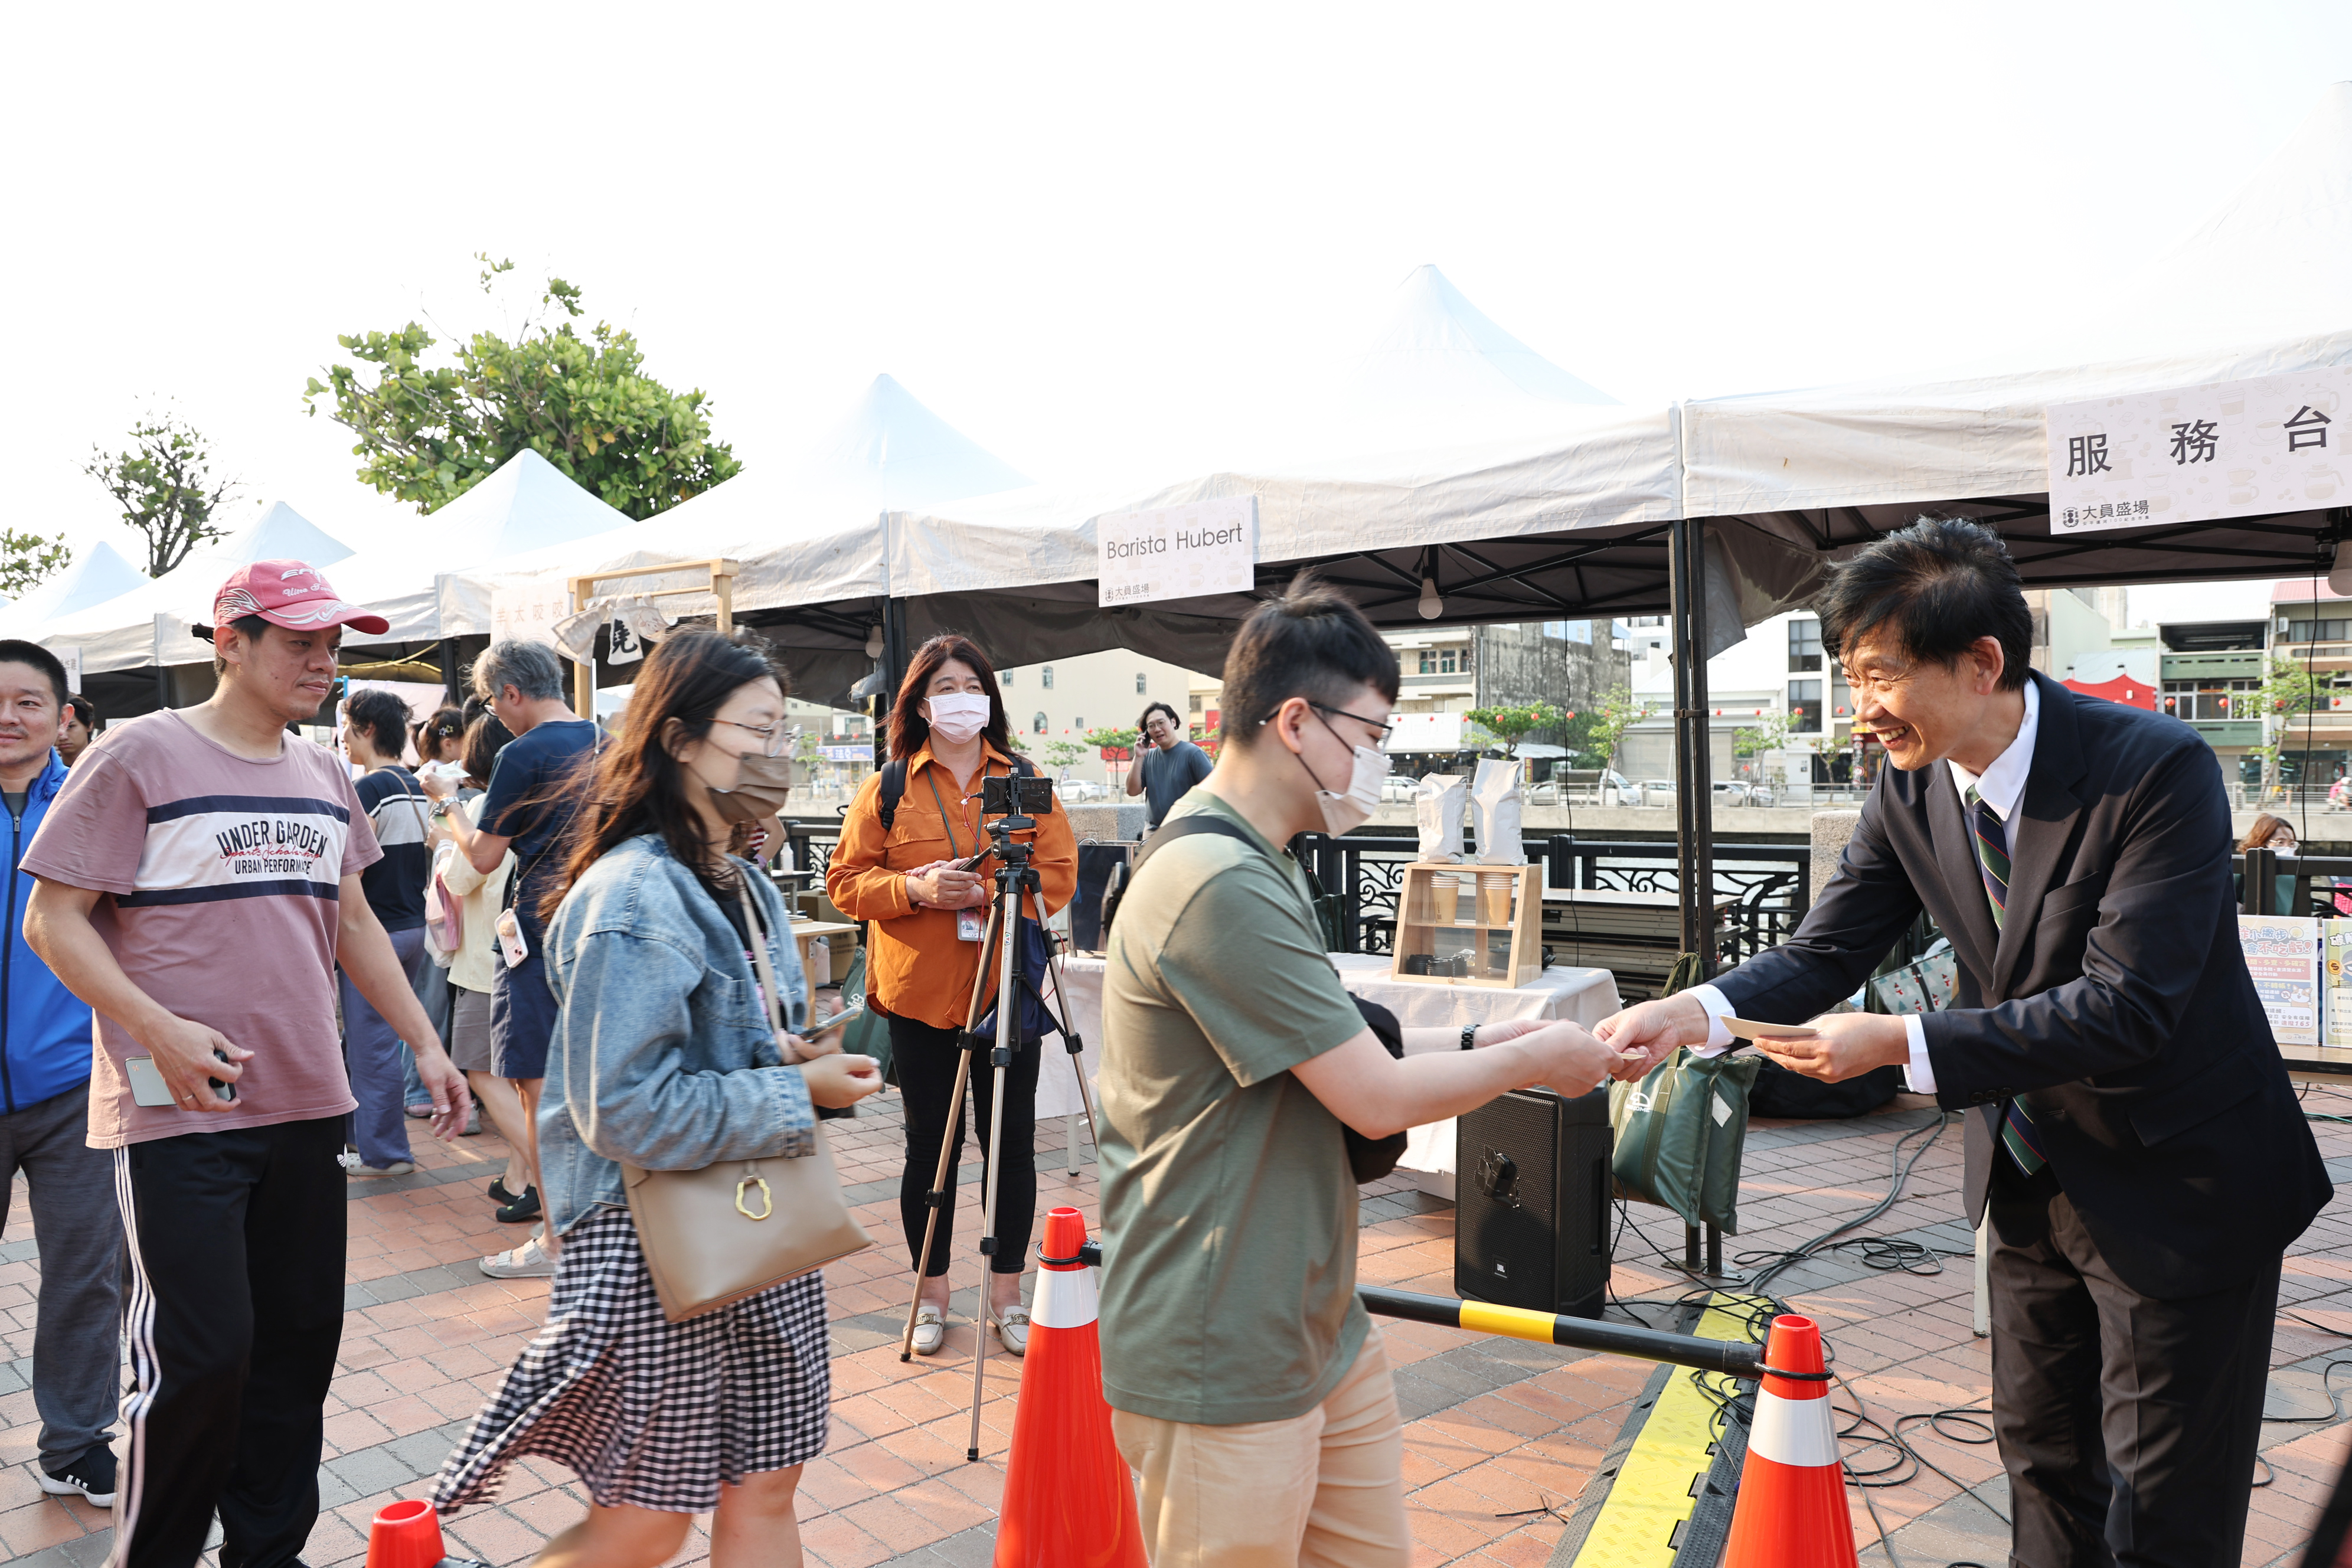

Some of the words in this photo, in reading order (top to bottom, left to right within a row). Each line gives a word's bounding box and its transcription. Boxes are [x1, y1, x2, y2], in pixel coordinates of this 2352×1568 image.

[2067, 405, 2333, 477] 服務台
[2082, 499, 2150, 520] 大員盛場
[1107, 535, 1167, 560] Barista
[1177, 522, 1243, 550] Hubert
[1115, 583, 1150, 597] 大員盛場
[216, 820, 269, 857] UNDER
[276, 819, 328, 858] GARDEN
[220, 845, 262, 867] Sports
[235, 859, 263, 874] URBAN
[1497, 1263, 1505, 1273] JBL
